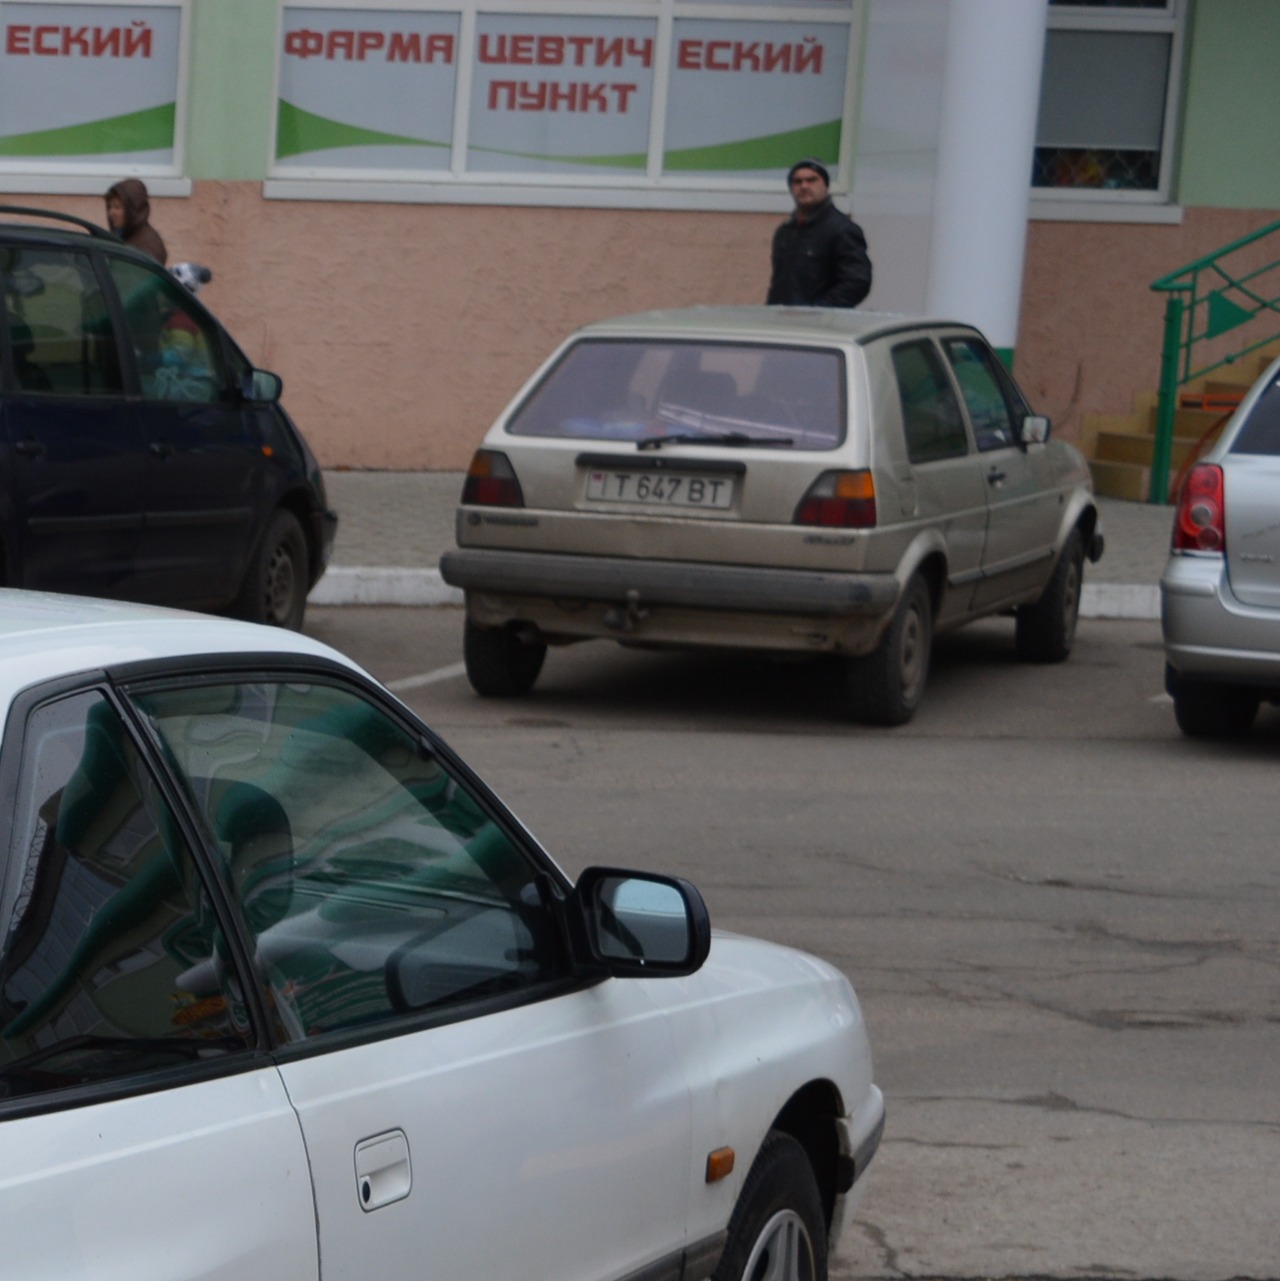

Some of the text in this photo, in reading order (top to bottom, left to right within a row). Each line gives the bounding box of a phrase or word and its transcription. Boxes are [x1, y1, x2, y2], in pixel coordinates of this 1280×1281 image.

[6, 20, 153, 58] ЕСКИЙ
[283, 28, 823, 74] ФАРМА ЦЕВТИЧ ЕСКИЙ
[488, 79, 637, 113] ПУНКТ
[614, 473, 724, 505] T 647 BT
